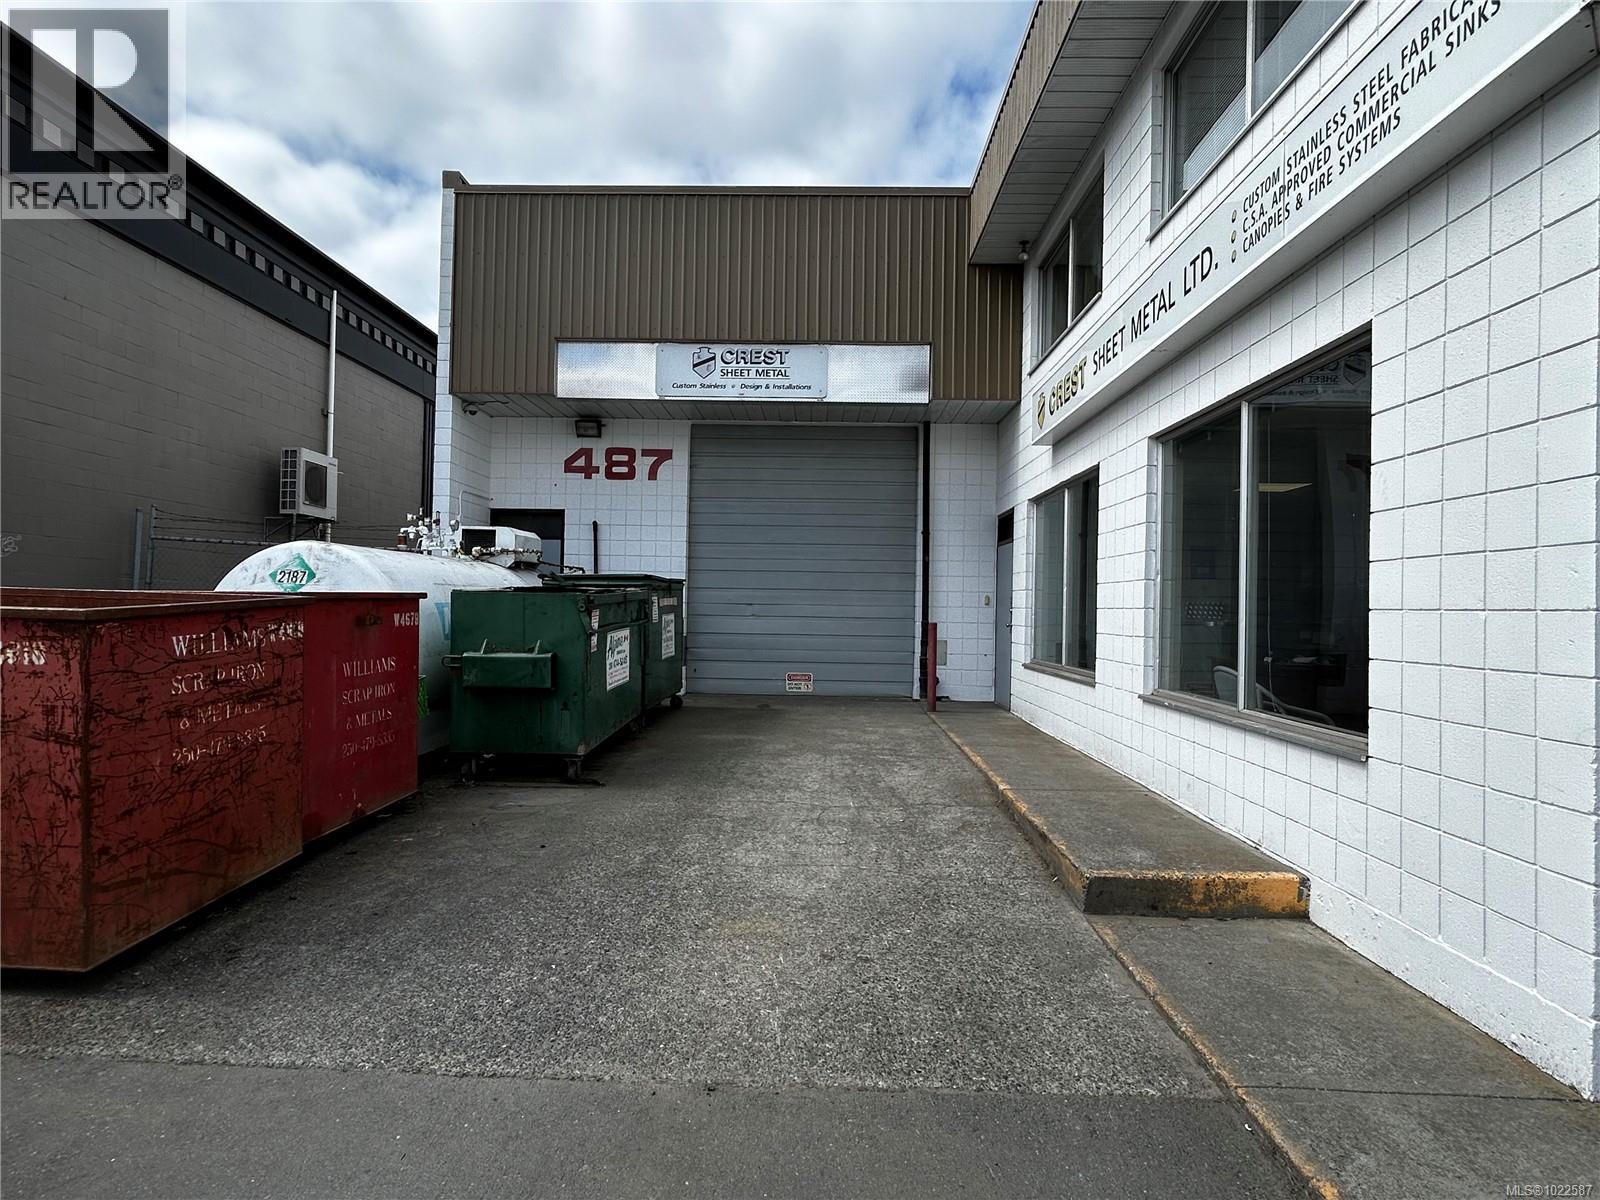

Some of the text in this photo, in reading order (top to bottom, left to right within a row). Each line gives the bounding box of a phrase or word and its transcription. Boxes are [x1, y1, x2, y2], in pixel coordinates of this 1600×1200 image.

[1242, 0, 1501, 233] C.S.A. APPROVED COMMERCIAL SINKS
[1243, 167, 1281, 213] CUSTOM
[1286, 105, 1347, 175] STAINLESS
[1353, 62, 1394, 114] STEEL
[1242, 106, 1401, 253] CANOPIES & FIRE SYSTEMS
[1049, 246, 1219, 416] CREST SHEET METAL LTD.
[720, 349, 790, 365] CREST
[720, 368, 789, 378] SHEET METAL
[699, 382, 726, 390] Stainless
[740, 383, 763, 391] Design
[563, 447, 673, 481] 487
[277, 570, 307, 583] 2187
[342, 656, 397, 678] WILLIAMS
[342, 682, 396, 705] SCRAP IRON
[355, 708, 393, 728] METALS
